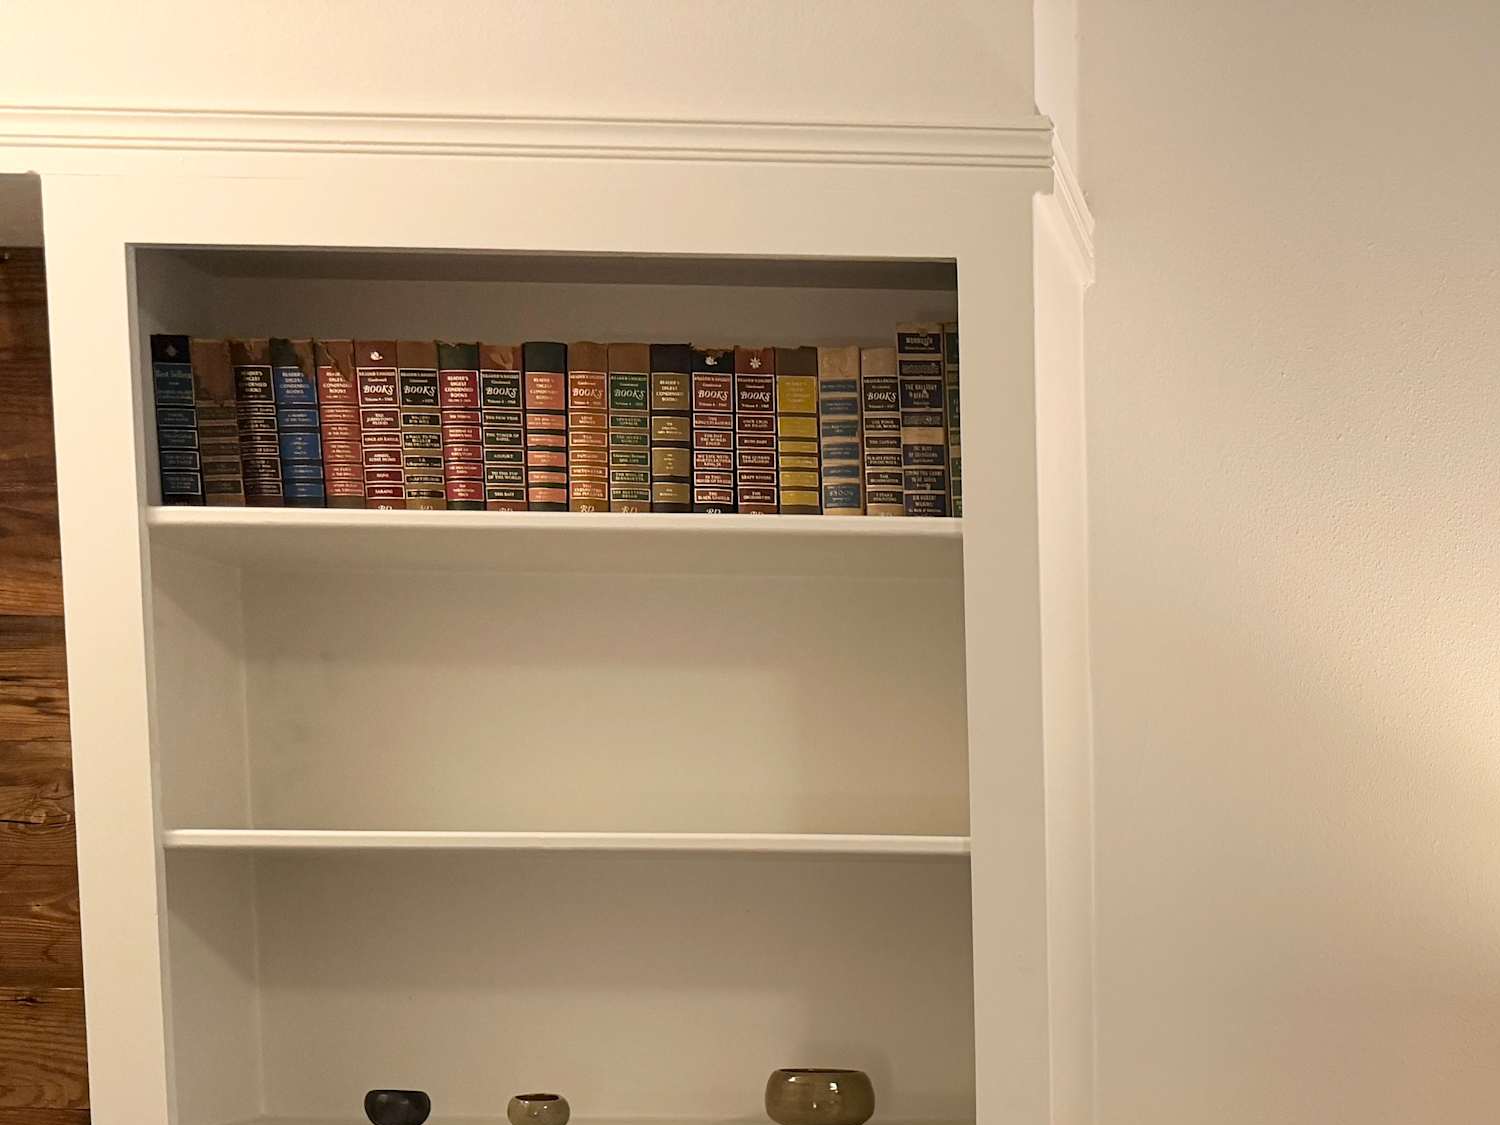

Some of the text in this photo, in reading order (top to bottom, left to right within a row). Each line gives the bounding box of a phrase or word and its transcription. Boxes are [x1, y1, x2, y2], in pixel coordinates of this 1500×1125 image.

[363, 385, 395, 396] BOOKS
[403, 386, 437, 397] BOOKS
[486, 387, 517, 398] BOOKS
[572, 388, 602, 400] BOOKS
[614, 389, 645, 401] BOOKS
[697, 389, 729, 401] BOOKS
[740, 391, 772, 402] BOOKS
[867, 391, 897, 403] BOOKS
